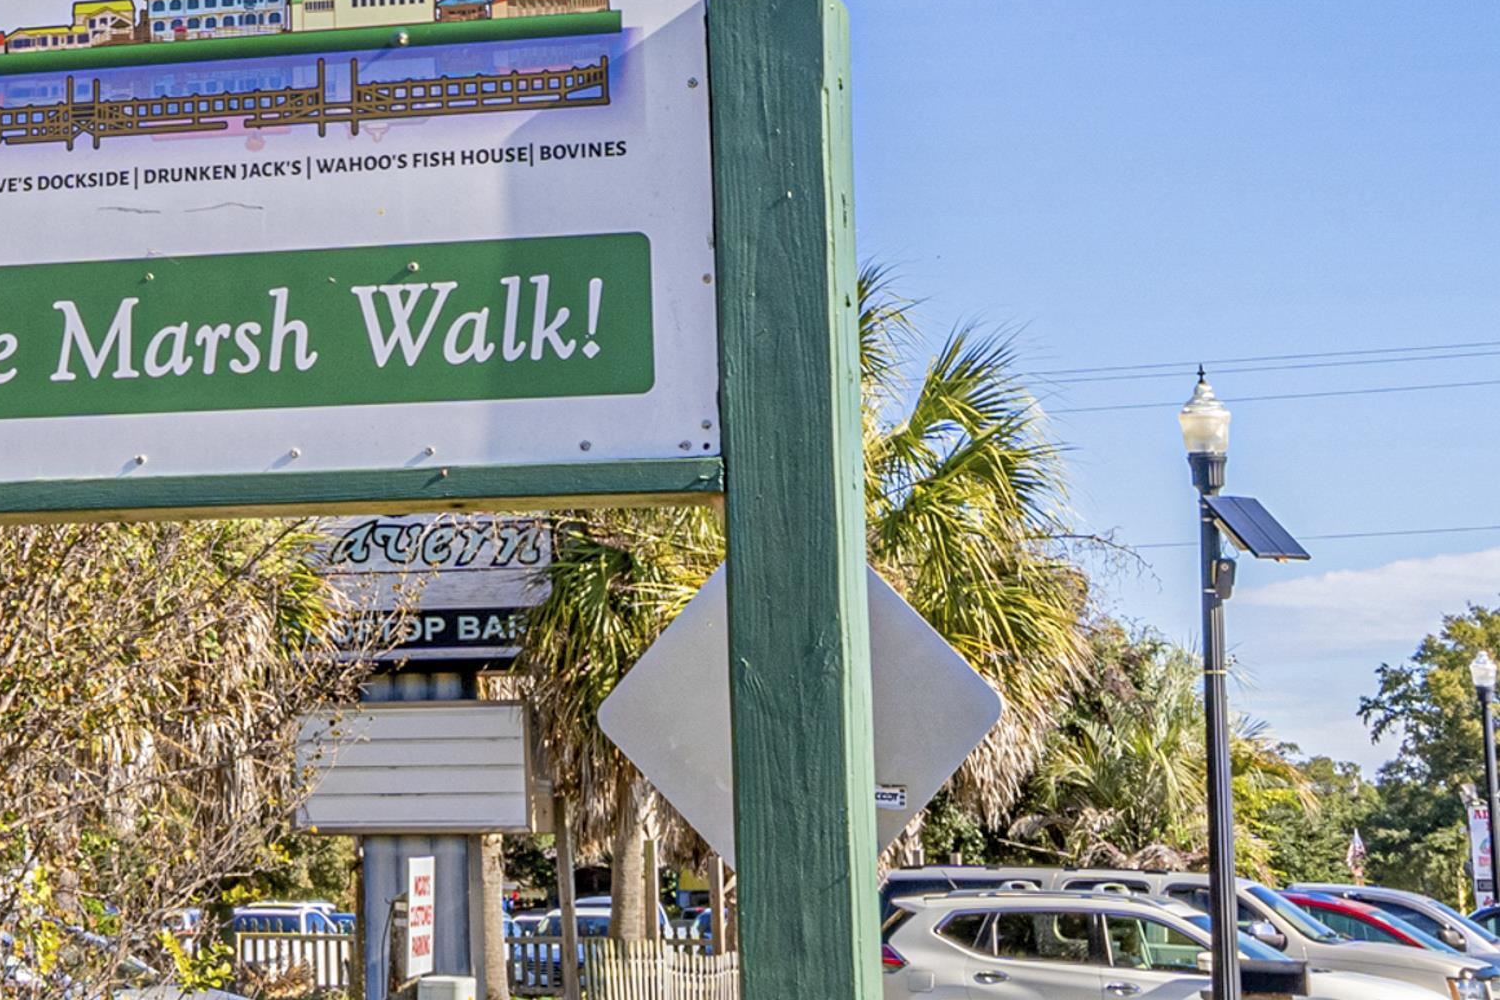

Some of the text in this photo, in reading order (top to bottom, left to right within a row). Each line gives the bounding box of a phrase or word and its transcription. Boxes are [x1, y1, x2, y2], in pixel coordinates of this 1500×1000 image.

[37, 170, 130, 191] DOCKSIDE
[144, 164, 237, 184] DRUNKEN
[241, 159, 302, 181] JACK'S
[316, 153, 408, 174] WAHOO'S
[412, 151, 455, 168] FISH
[460, 146, 528, 166] HOUSE
[539, 140, 627, 161] BOVINES
[50, 287, 318, 382] Marsh
[350, 274, 603, 368] Walk!
